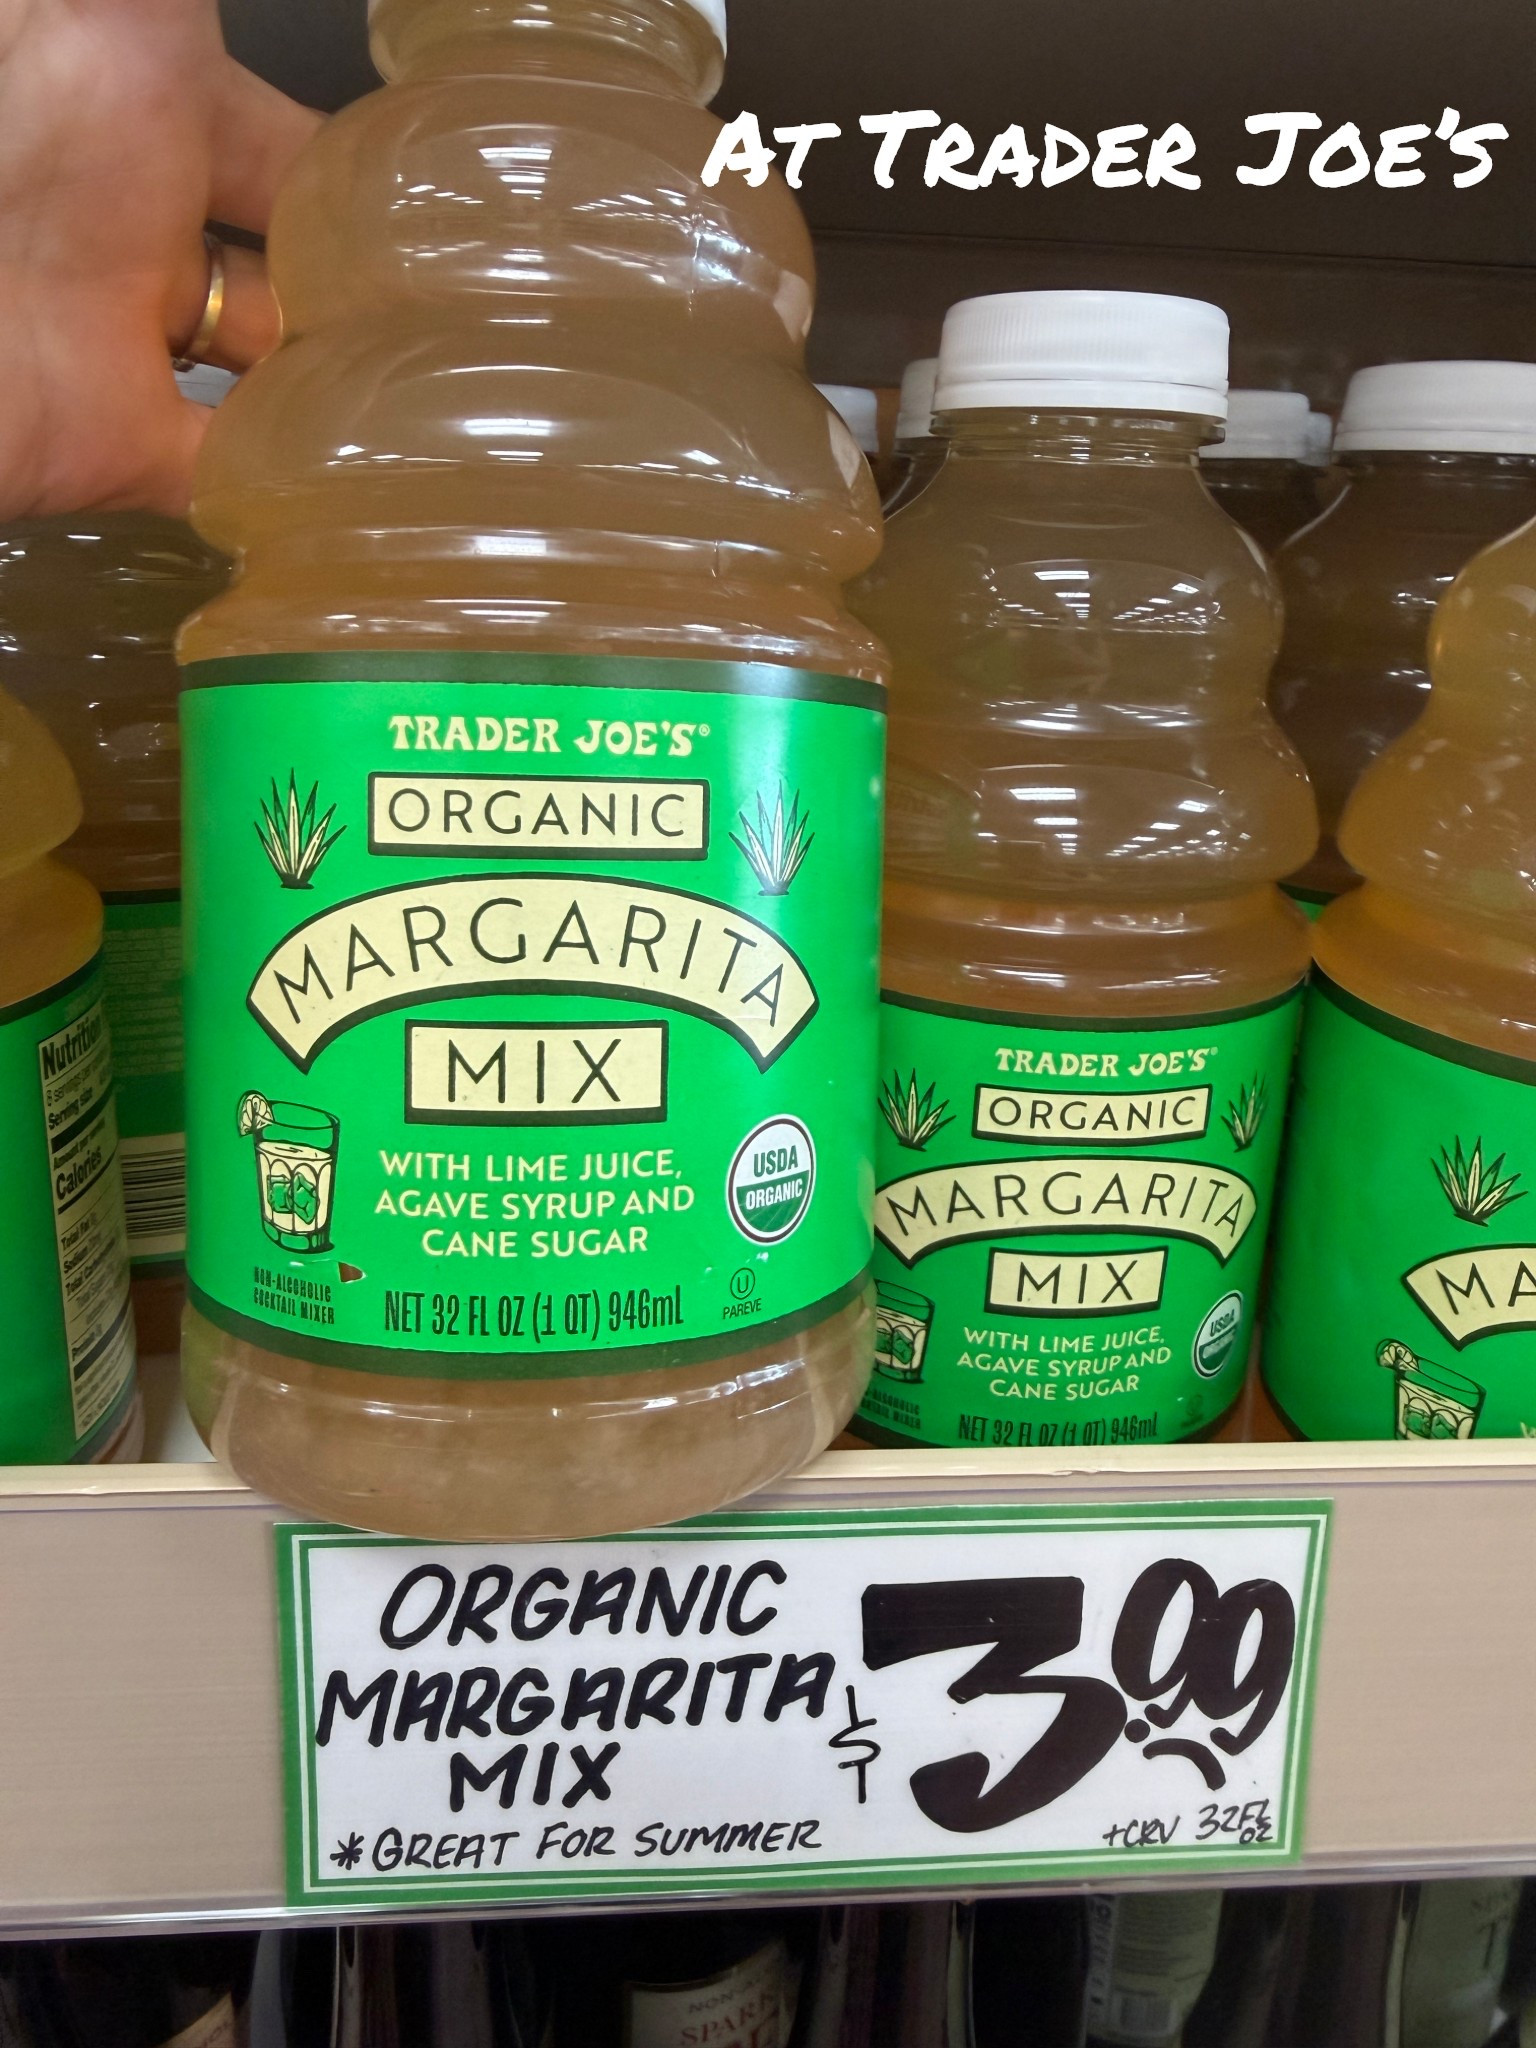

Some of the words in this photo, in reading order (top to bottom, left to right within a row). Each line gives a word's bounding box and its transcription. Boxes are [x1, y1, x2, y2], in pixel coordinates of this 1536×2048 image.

[389, 716, 561, 753] TRADER
[388, 788, 686, 838] ORGANIC
[273, 897, 786, 1028] MARGARITA
[447, 1038, 622, 1105] MIX
[995, 1047, 1120, 1077] TRADER
[989, 1095, 1197, 1133] ORGANIC
[56, 1145, 102, 1201] Calories
[380, 1151, 471, 1182] WITH
[485, 1153, 569, 1182] LIME
[578, 1149, 683, 1182] JUICE,
[753, 1145, 799, 1178] USDA
[375, 1190, 494, 1220] AGAVE
[502, 1191, 617, 1221] SYRUP
[621, 1186, 696, 1213] AND
[745, 1178, 803, 1210] ORGANIC
[885, 1171, 1244, 1239] MARGARITA
[422, 1230, 520, 1258] CANE
[530, 1227, 650, 1258] SUGAR
[254, 1266, 332, 1303] NON-ALCOHOLIC
[1017, 1259, 1139, 1305] MIX
[254, 1286, 297, 1317] COCKTAIL
[300, 1301, 335, 1325] MIXER
[384, 1290, 426, 1334] NET
[431, 1293, 460, 1336] 32
[468, 1295, 490, 1337] FL
[498, 1295, 525, 1337] OZ
[532, 1291, 556, 1344] (1
[564, 1289, 600, 1342] QT)
[723, 1298, 762, 1320] PAREVE
[963, 1326, 1029, 1351] WITH
[1039, 1335, 1095, 1354] LIME
[957, 1351, 1040, 1377] AGAVE
[1047, 1355, 1122, 1377] SYRUP
[1124, 1346, 1172, 1369] AND
[989, 1378, 1058, 1401] CANE
[1065, 1374, 1140, 1401] SUGAR
[959, 1413, 989, 1443] NET
[993, 1419, 1014, 1446] 32
[380, 1559, 788, 1650] ORGANIC
[315, 1651, 836, 1747] MARGARITA
[449, 1741, 621, 1812] MIX
[535, 1821, 617, 1862] FOR
[634, 1819, 823, 1858] SUMMER
